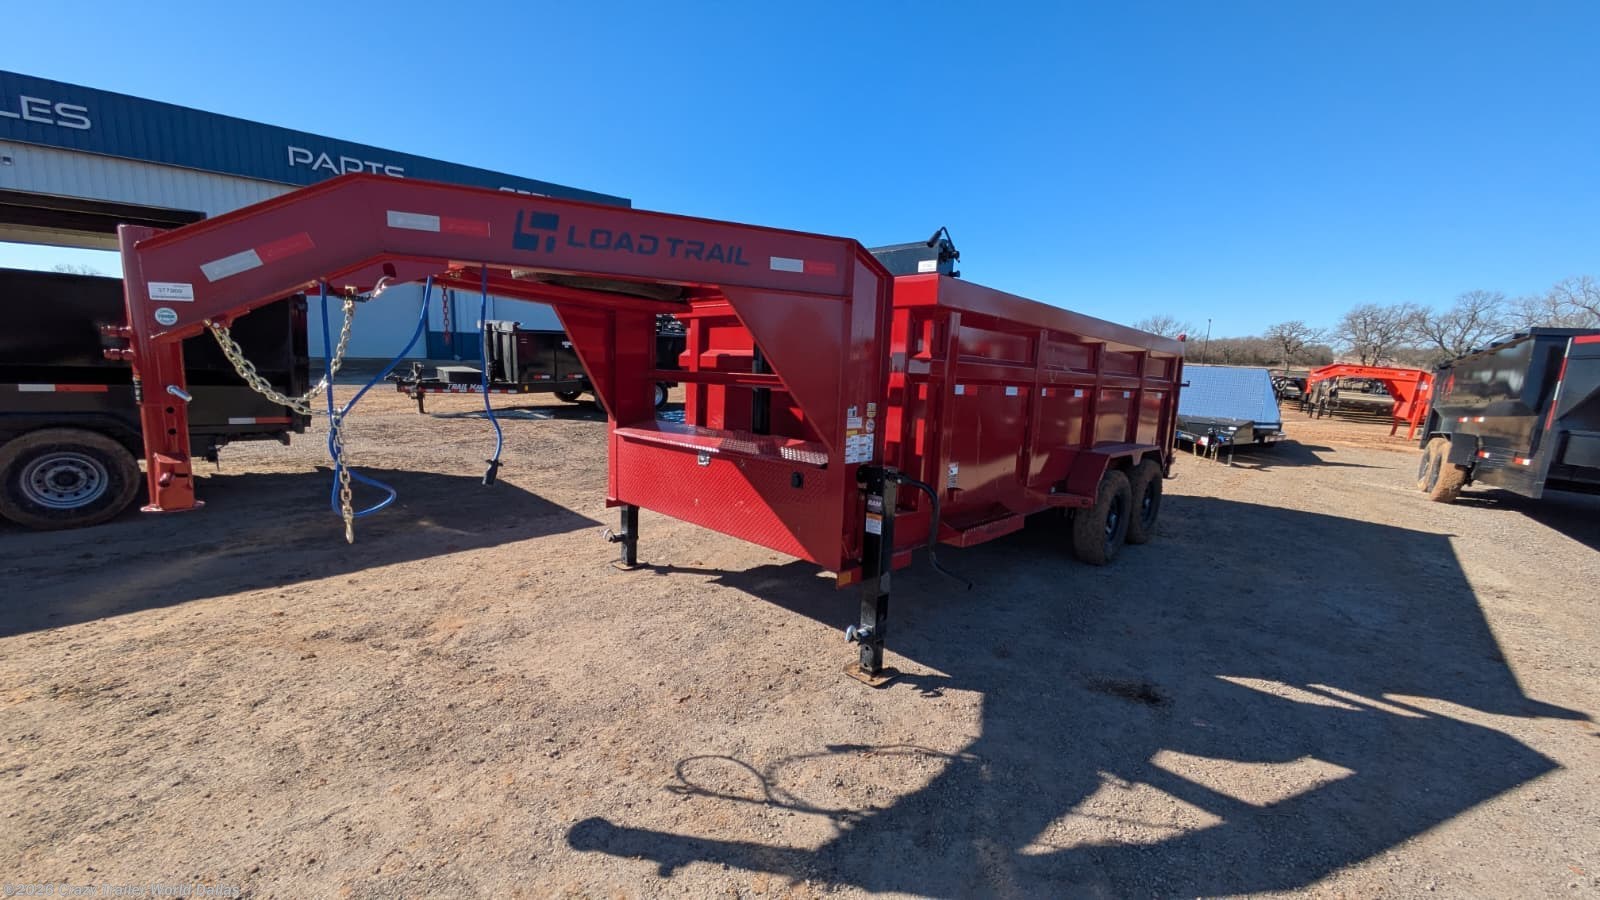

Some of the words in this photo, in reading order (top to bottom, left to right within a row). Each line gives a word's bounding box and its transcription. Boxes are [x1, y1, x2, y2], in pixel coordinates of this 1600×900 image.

[287, 145, 404, 178] PARTS
[567, 225, 659, 256] LOAD
[666, 237, 750, 267] TRAIL
